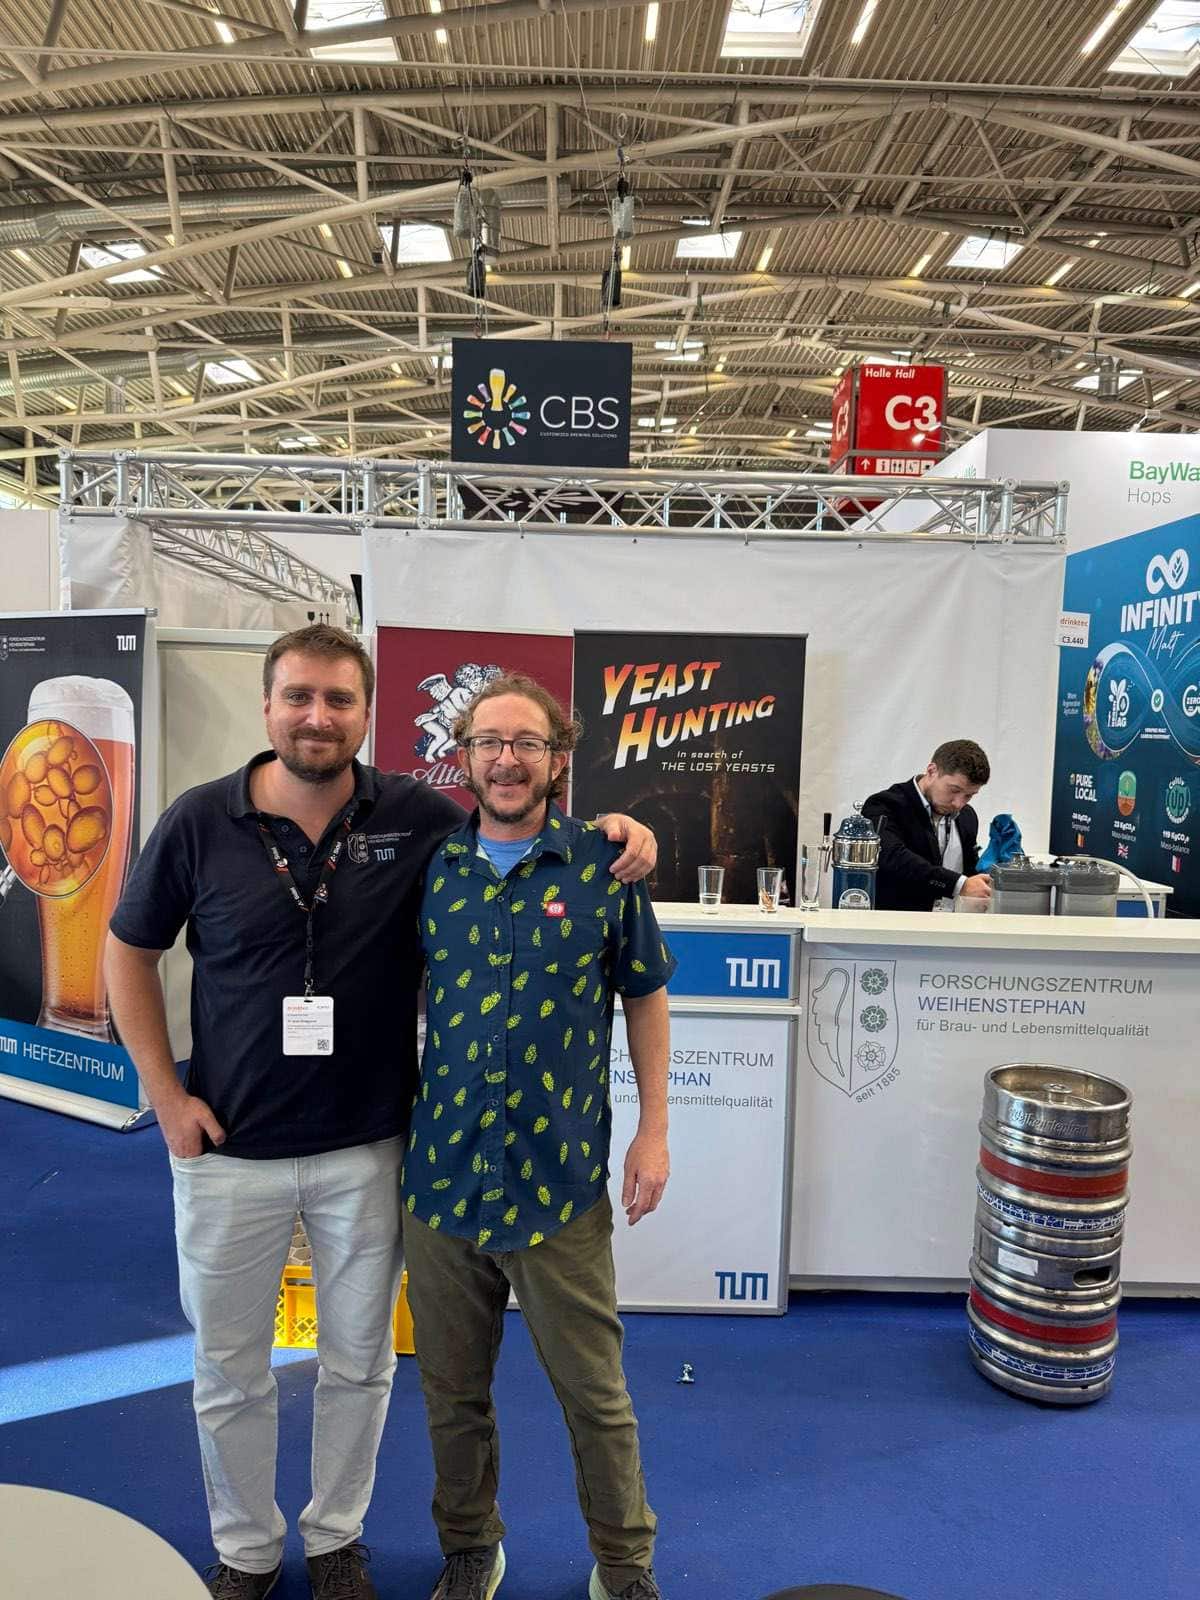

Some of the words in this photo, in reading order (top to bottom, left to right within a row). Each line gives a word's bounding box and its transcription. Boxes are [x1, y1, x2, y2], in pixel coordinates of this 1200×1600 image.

[865, 368, 891, 378] Halle
[895, 369, 916, 379] Hall
[540, 395, 620, 430] CBS
[885, 395, 937, 431] C3
[1128, 487, 1172, 506] Hops
[1120, 591, 1200, 633] INFINIT
[116, 635, 136, 651] TUM
[1062, 635, 1084, 645] C3.440
[1145, 624, 1185, 660] Malt
[602, 661, 722, 716] YEAST
[613, 694, 777, 770] HUNTING
[731, 750, 744, 759] of
[661, 762, 686, 771] THE
[690, 762, 721, 772] LOST
[725, 763, 776, 773] YEASTS
[1075, 773, 1094, 788] PURE
[1074, 787, 1098, 802] LOCAL
[374, 848, 395, 861] TUM
[726, 957, 781, 989] TUM
[919, 974, 1153, 995] FORSCHUNGSZENTRUM
[918, 996, 1085, 1015] WEIHENSTEPHAN
[916, 1019, 936, 1031] für
[939, 1019, 977, 1032] Brau-
[981, 1021, 1008, 1033] und
[1012, 1022, 1151, 1037] Lebensmittelqualität
[23, 1041, 124, 1081] HEFEZENTRUM
[856, 1088, 876, 1103] seit
[876, 1066, 901, 1090] 1885
[715, 1271, 768, 1301] TUM
